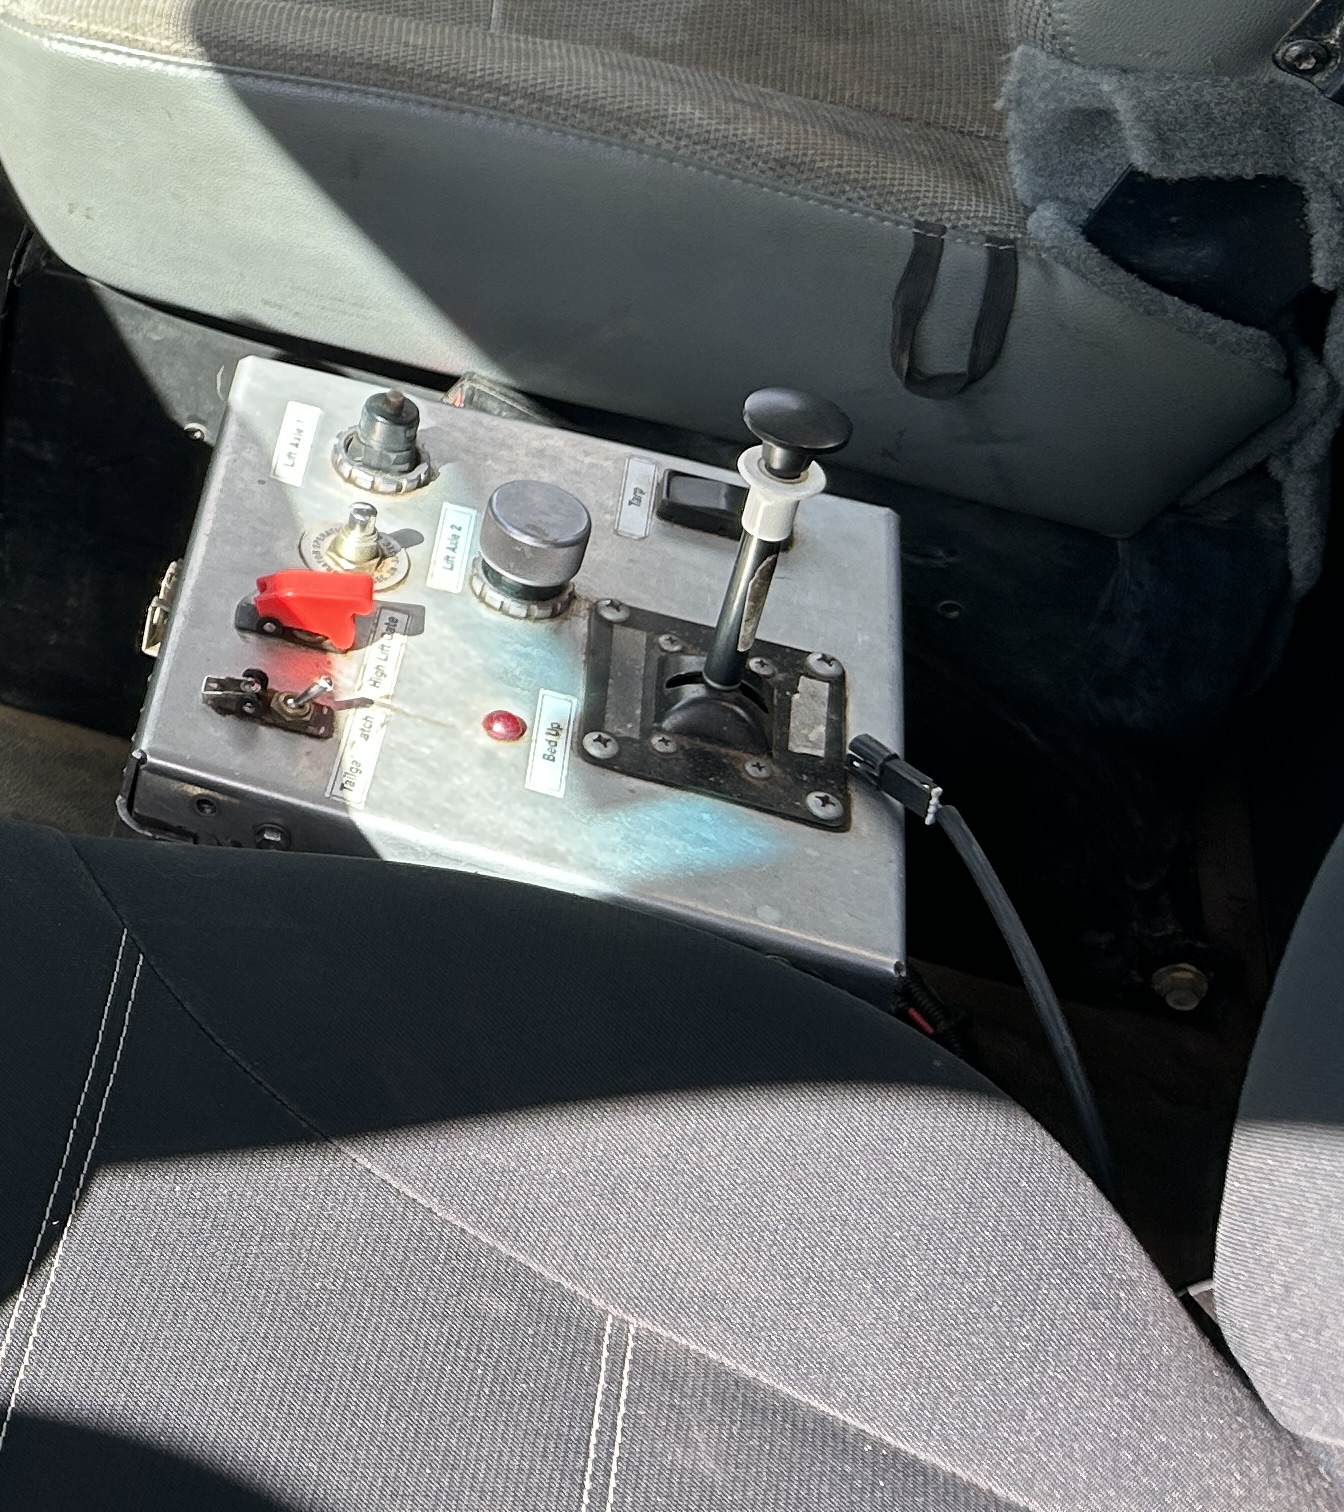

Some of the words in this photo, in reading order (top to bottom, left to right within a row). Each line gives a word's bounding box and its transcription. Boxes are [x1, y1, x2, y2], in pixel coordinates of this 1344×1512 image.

[288, 426, 305, 450] Axle
[283, 449, 298, 468] Lift
[628, 486, 647, 507] Tarp
[445, 529, 462, 554] Axle
[442, 553, 455, 571] Lift
[380, 615, 400, 640] Gate
[378, 642, 392, 662] Lift
[368, 662, 385, 689] High
[545, 722, 563, 738] Up
[542, 738, 558, 763] Bed
